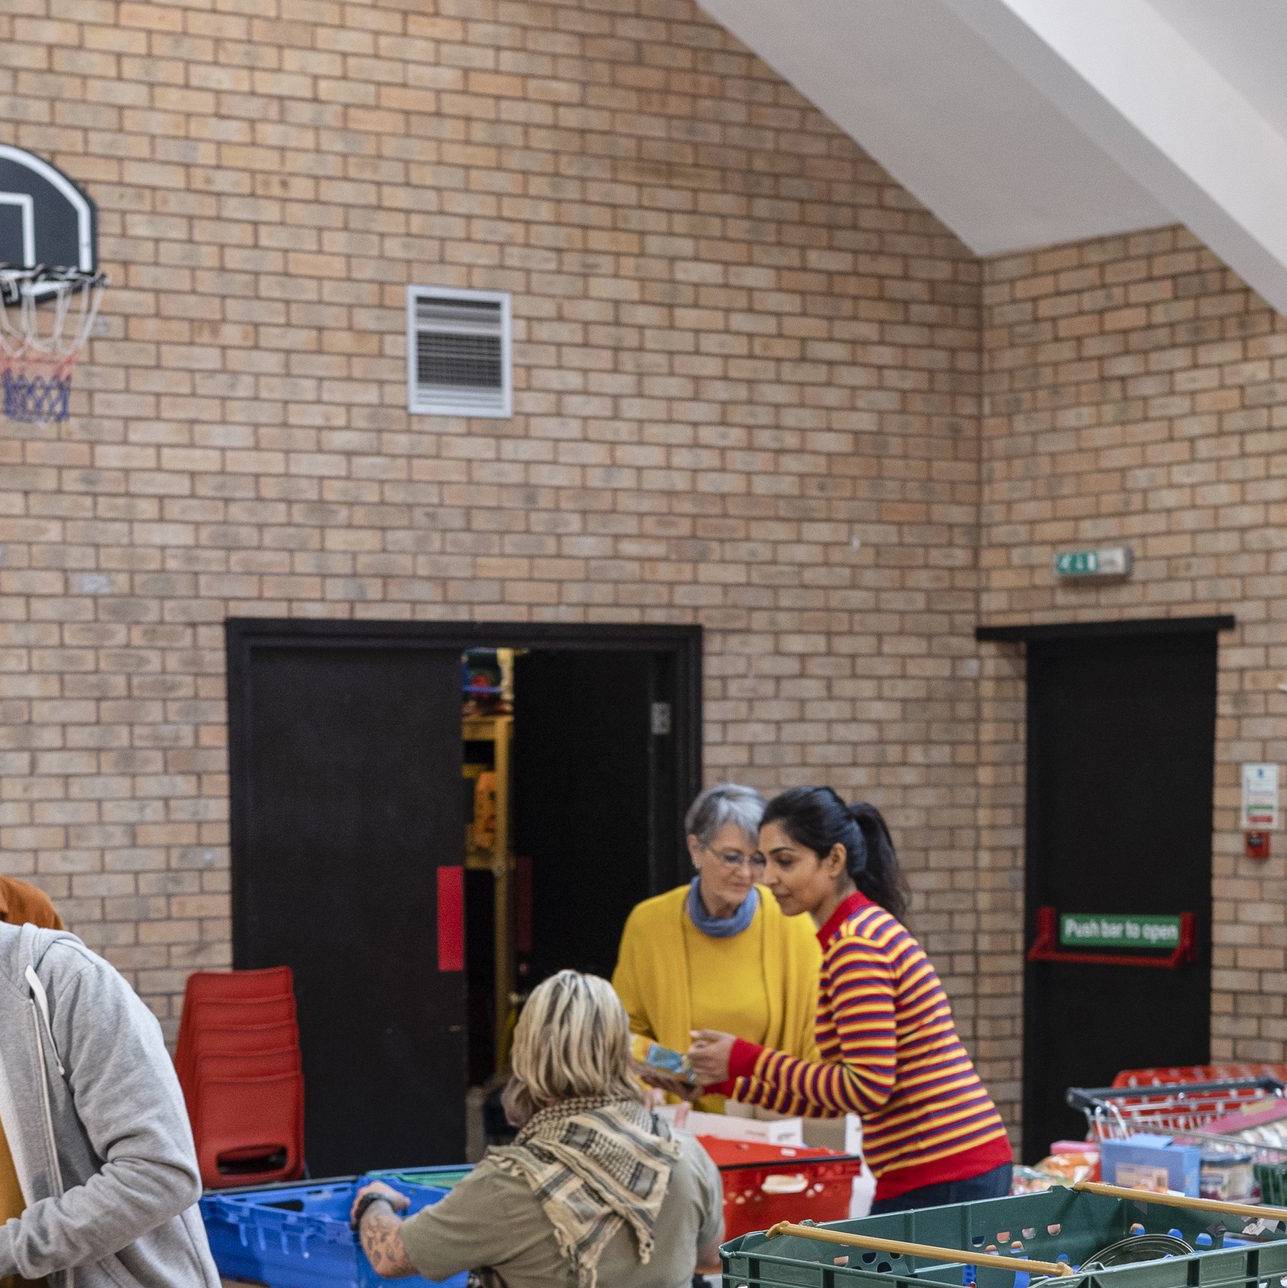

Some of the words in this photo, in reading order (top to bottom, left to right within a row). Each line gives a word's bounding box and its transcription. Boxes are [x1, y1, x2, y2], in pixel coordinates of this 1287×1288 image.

[1065, 918, 1100, 938] Push
[1100, 919, 1124, 938] bar
[1126, 921, 1141, 939] to
[1142, 923, 1179, 944] open
